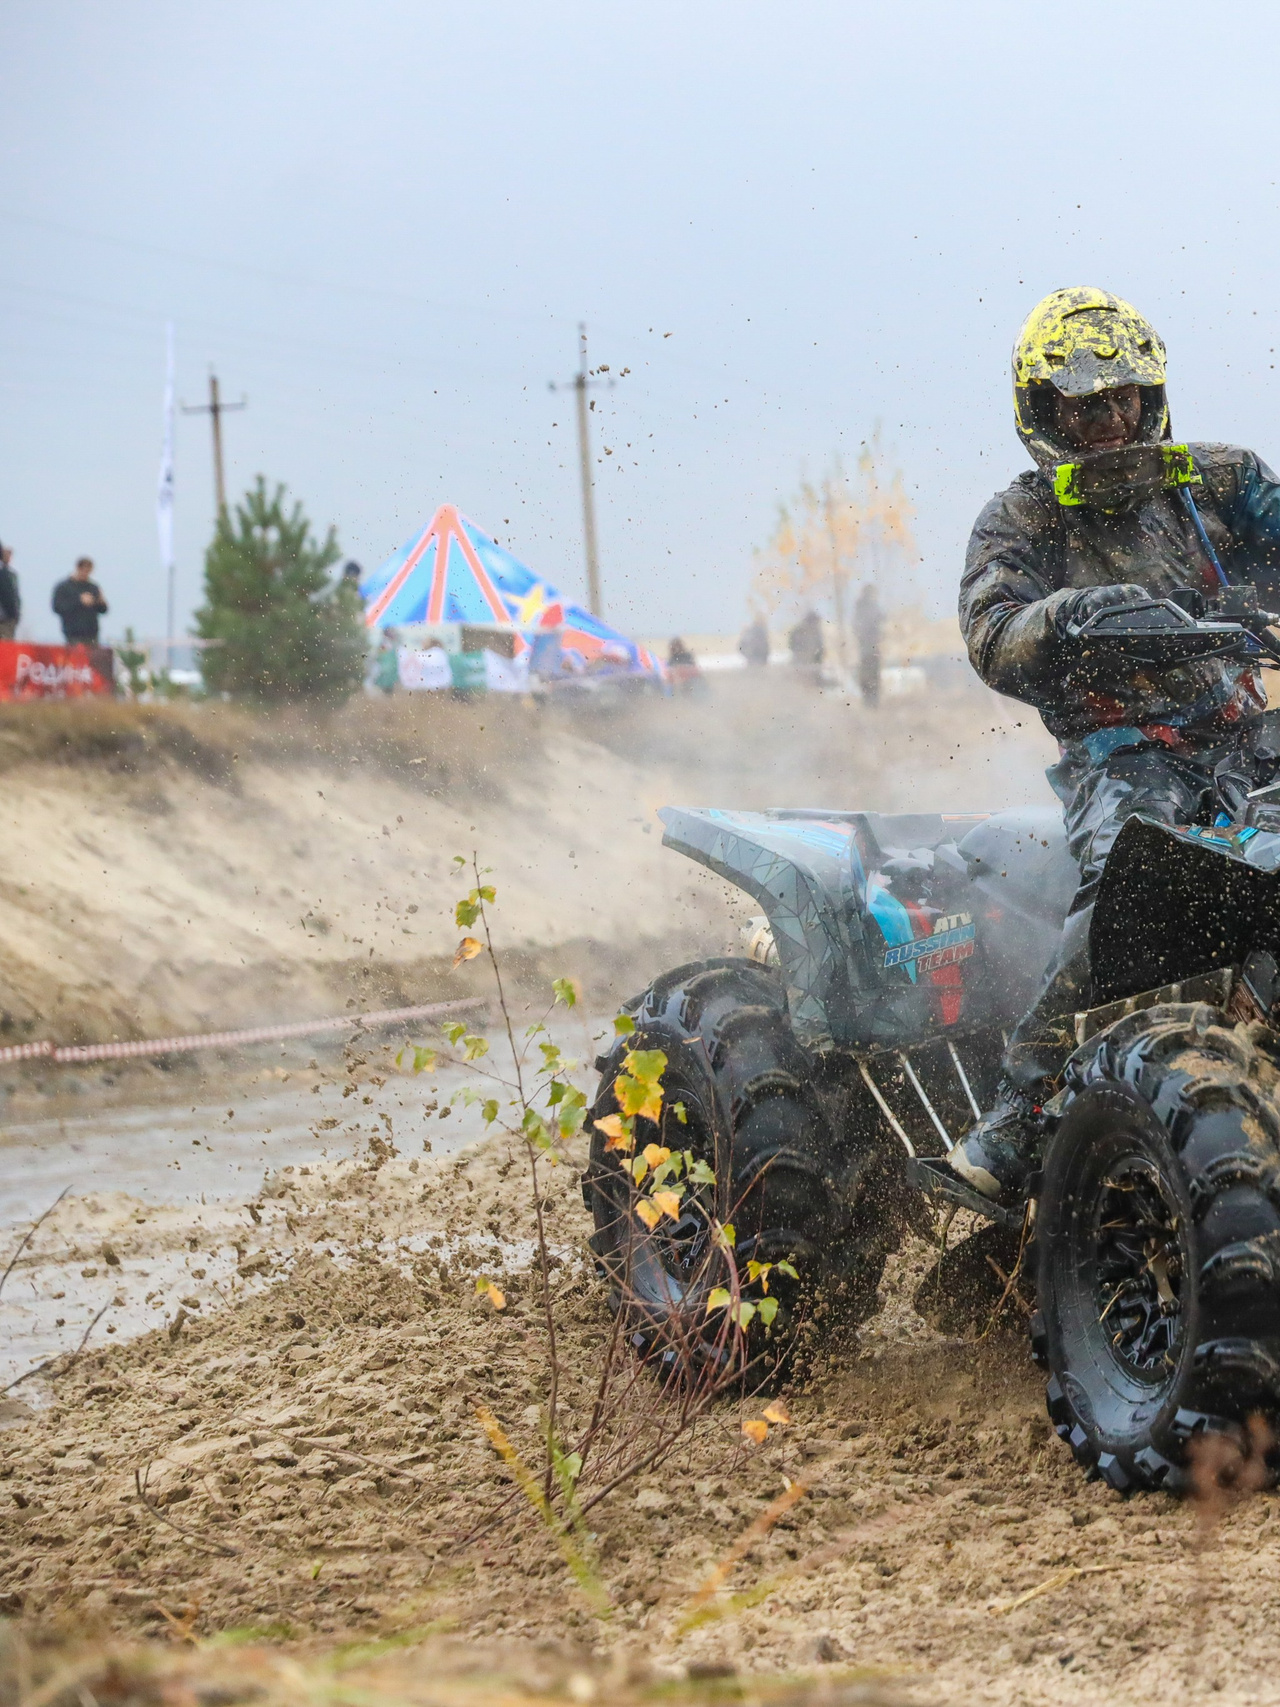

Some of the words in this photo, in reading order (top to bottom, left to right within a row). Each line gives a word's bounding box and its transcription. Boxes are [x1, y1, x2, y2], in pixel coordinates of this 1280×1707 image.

[933, 911, 973, 934] ATV
[884, 923, 975, 968] RUSSIAN
[918, 940, 975, 973] TEAM
